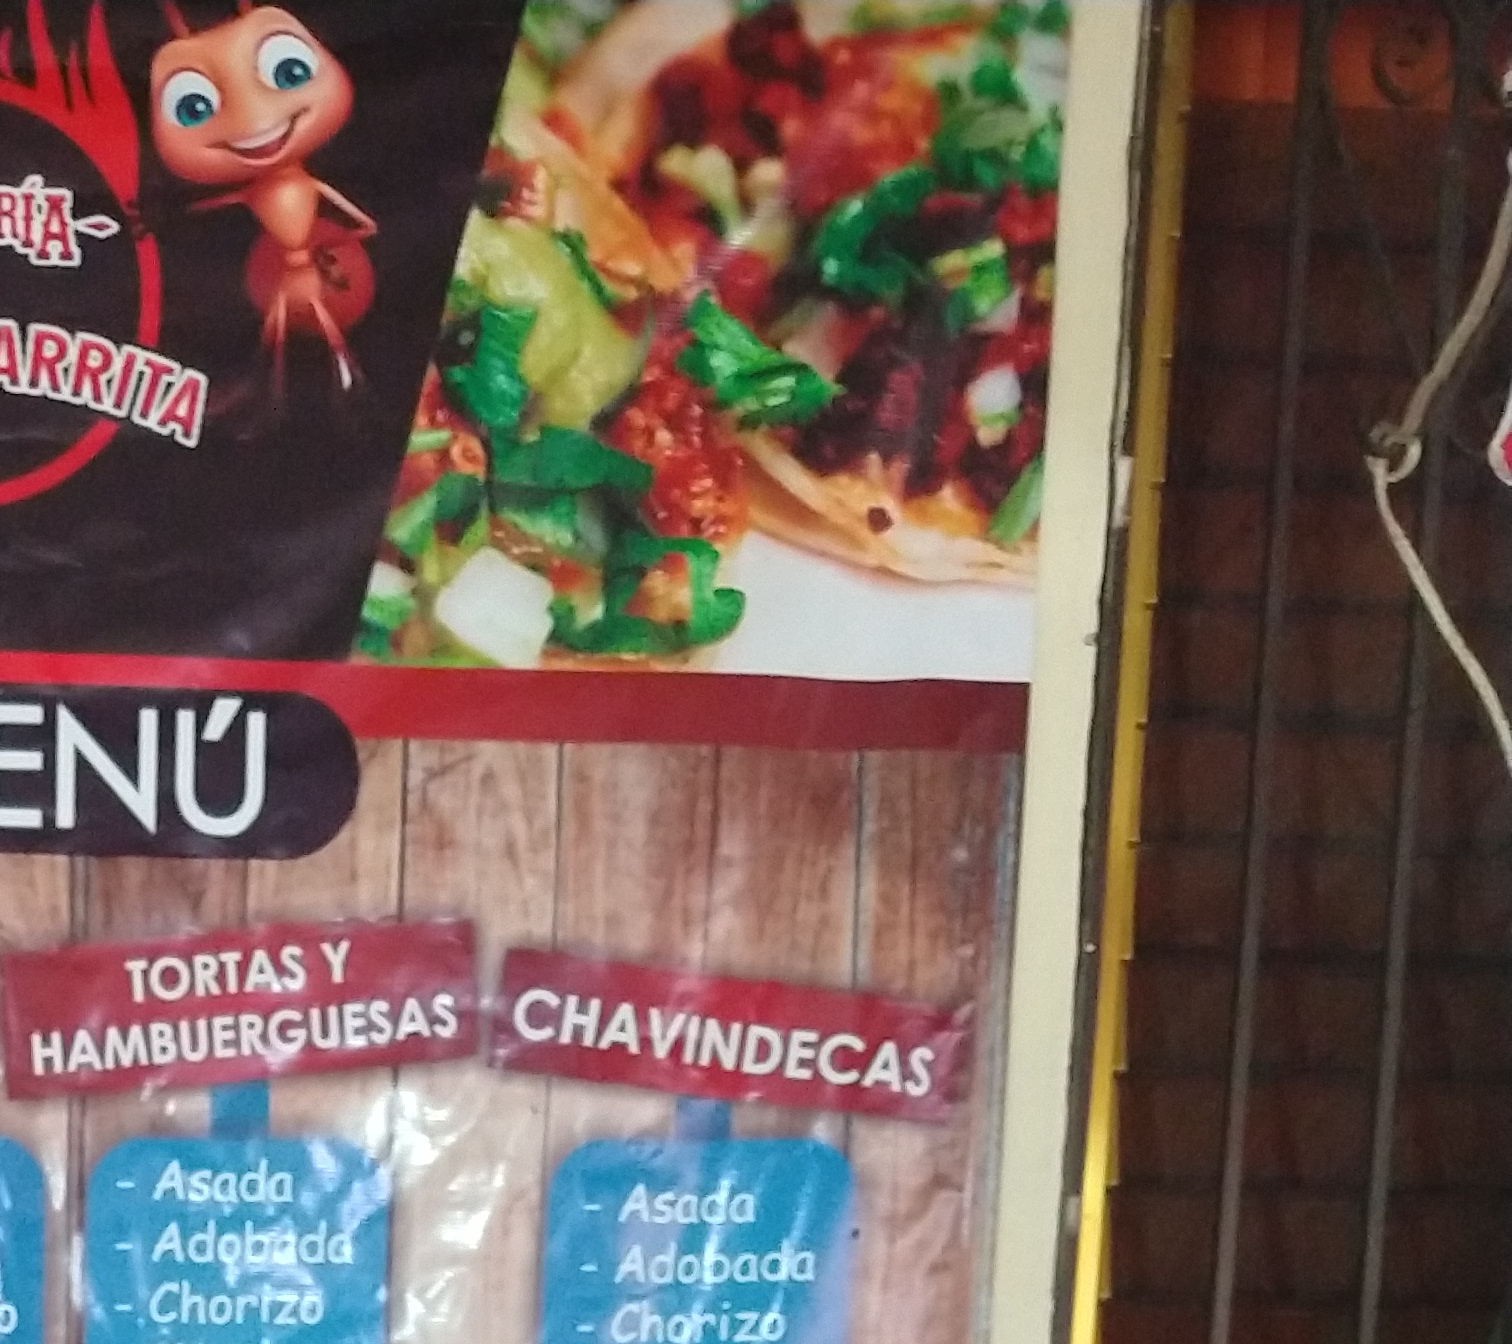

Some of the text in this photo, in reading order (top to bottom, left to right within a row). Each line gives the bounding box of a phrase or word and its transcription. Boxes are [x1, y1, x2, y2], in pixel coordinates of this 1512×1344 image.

[125, 939, 351, 1003] TORTAS Y
[30, 994, 457, 1076] HAMBUERGUESAS
[513, 989, 936, 1097] CHAVINDECAS
[152, 1159, 294, 1204] Asada
[617, 1182, 756, 1225] Asada
[152, 1220, 353, 1266] Adobada
[614, 1240, 816, 1284] Adobada
[149, 1282, 324, 1326] Chorizo
[609, 1301, 786, 1344] Chorizo
